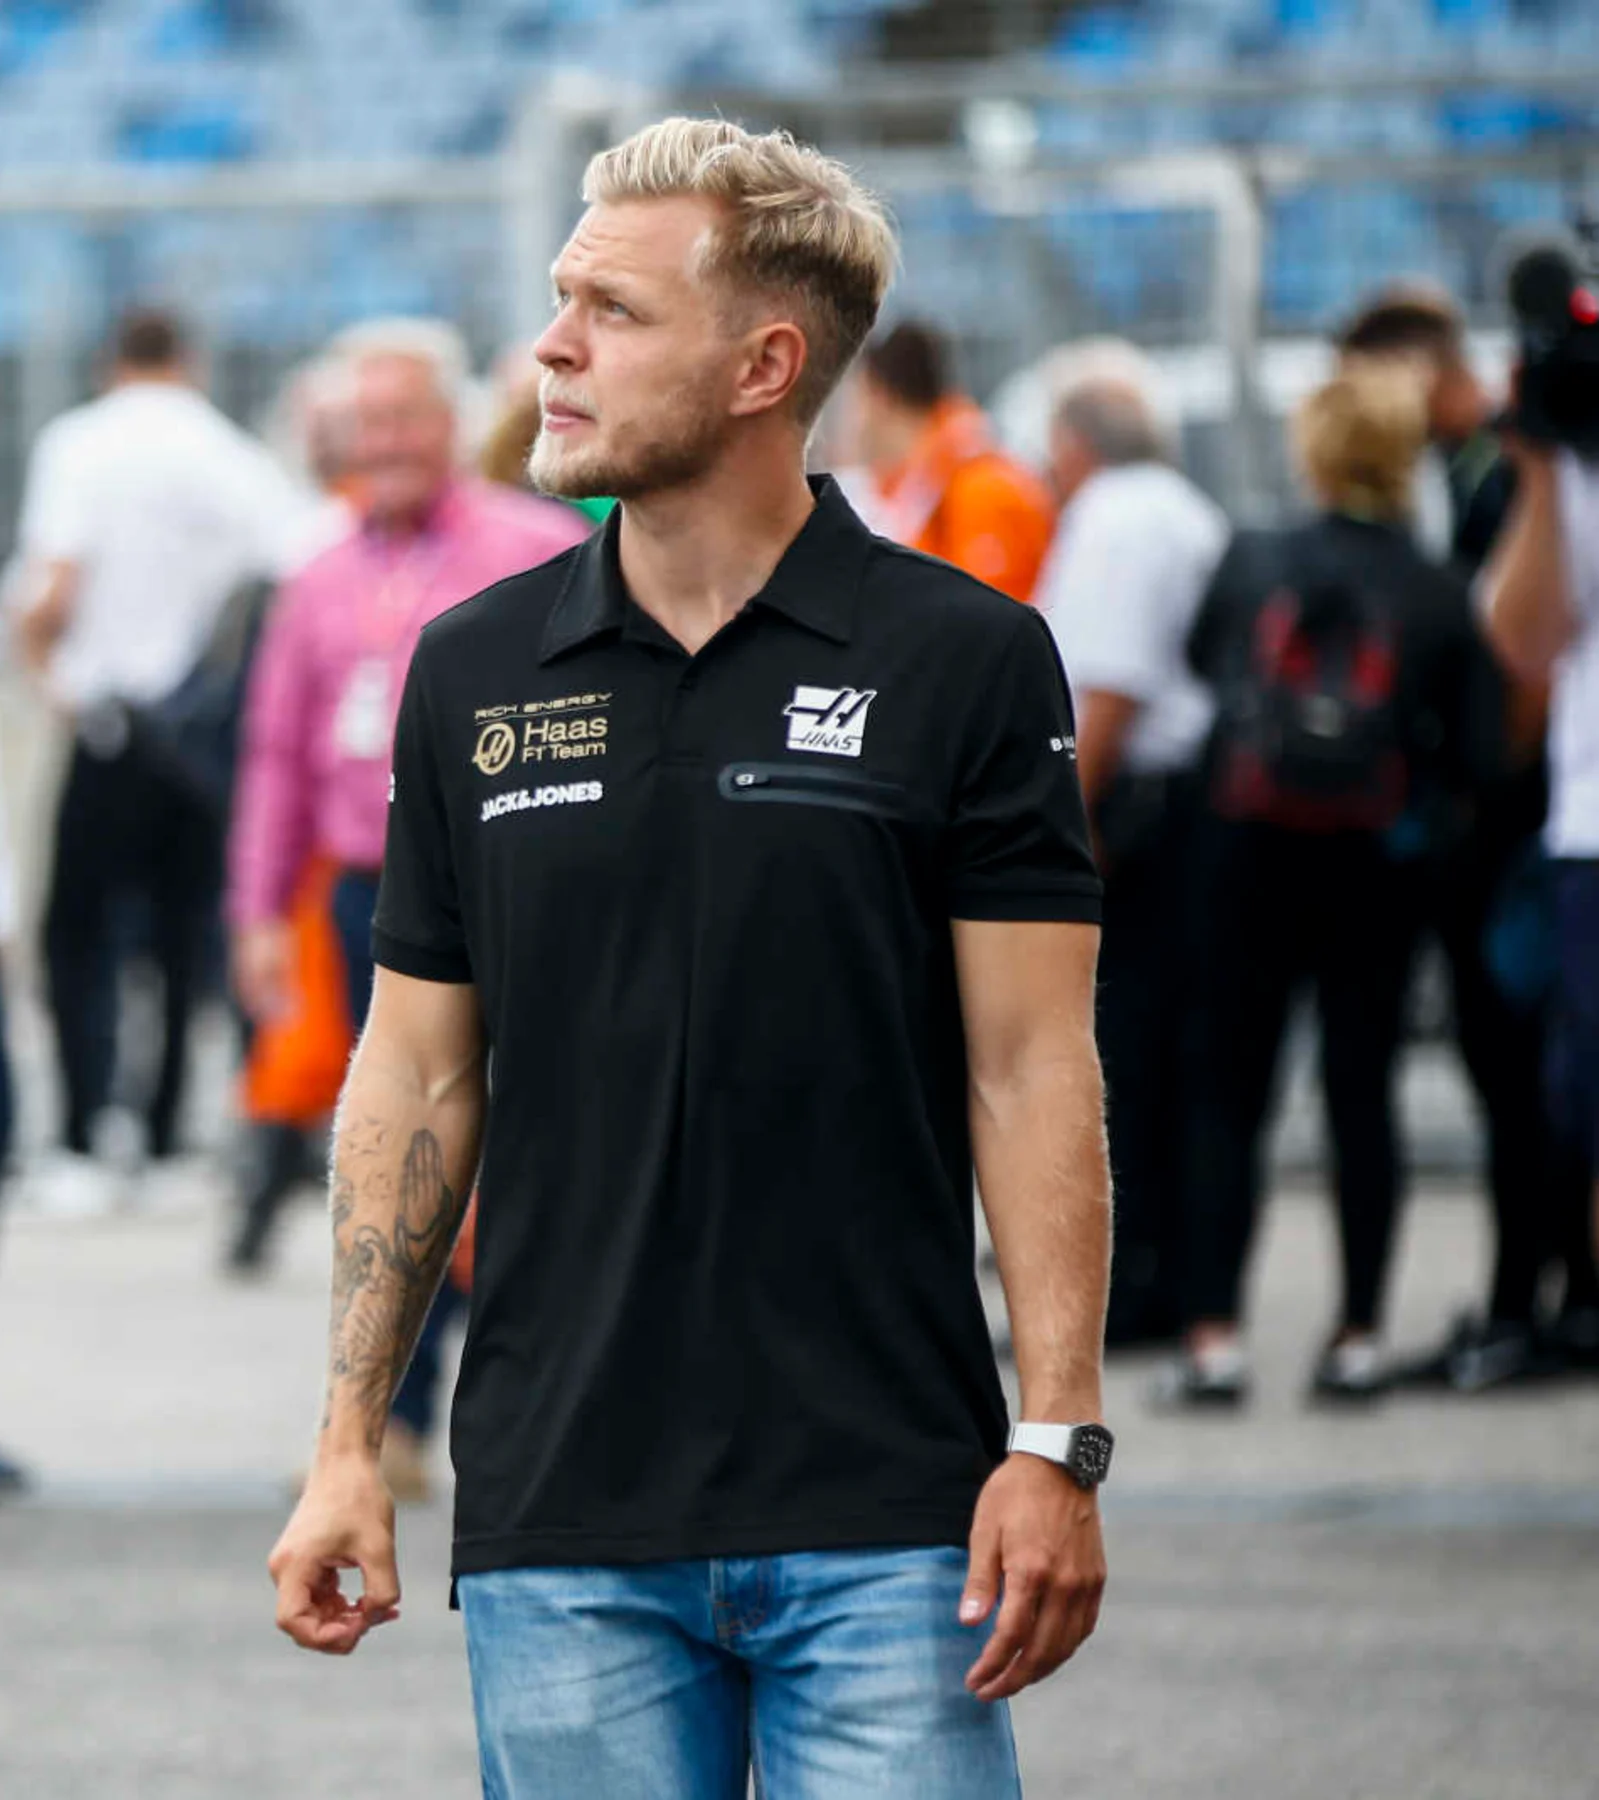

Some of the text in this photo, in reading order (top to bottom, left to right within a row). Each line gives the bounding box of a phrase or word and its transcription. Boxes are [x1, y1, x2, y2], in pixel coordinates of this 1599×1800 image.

[474, 692, 613, 720] RICH ENERGY
[523, 717, 609, 745] Haas
[522, 742, 606, 763] F1 Team
[481, 780, 603, 822] JACK&JONES
